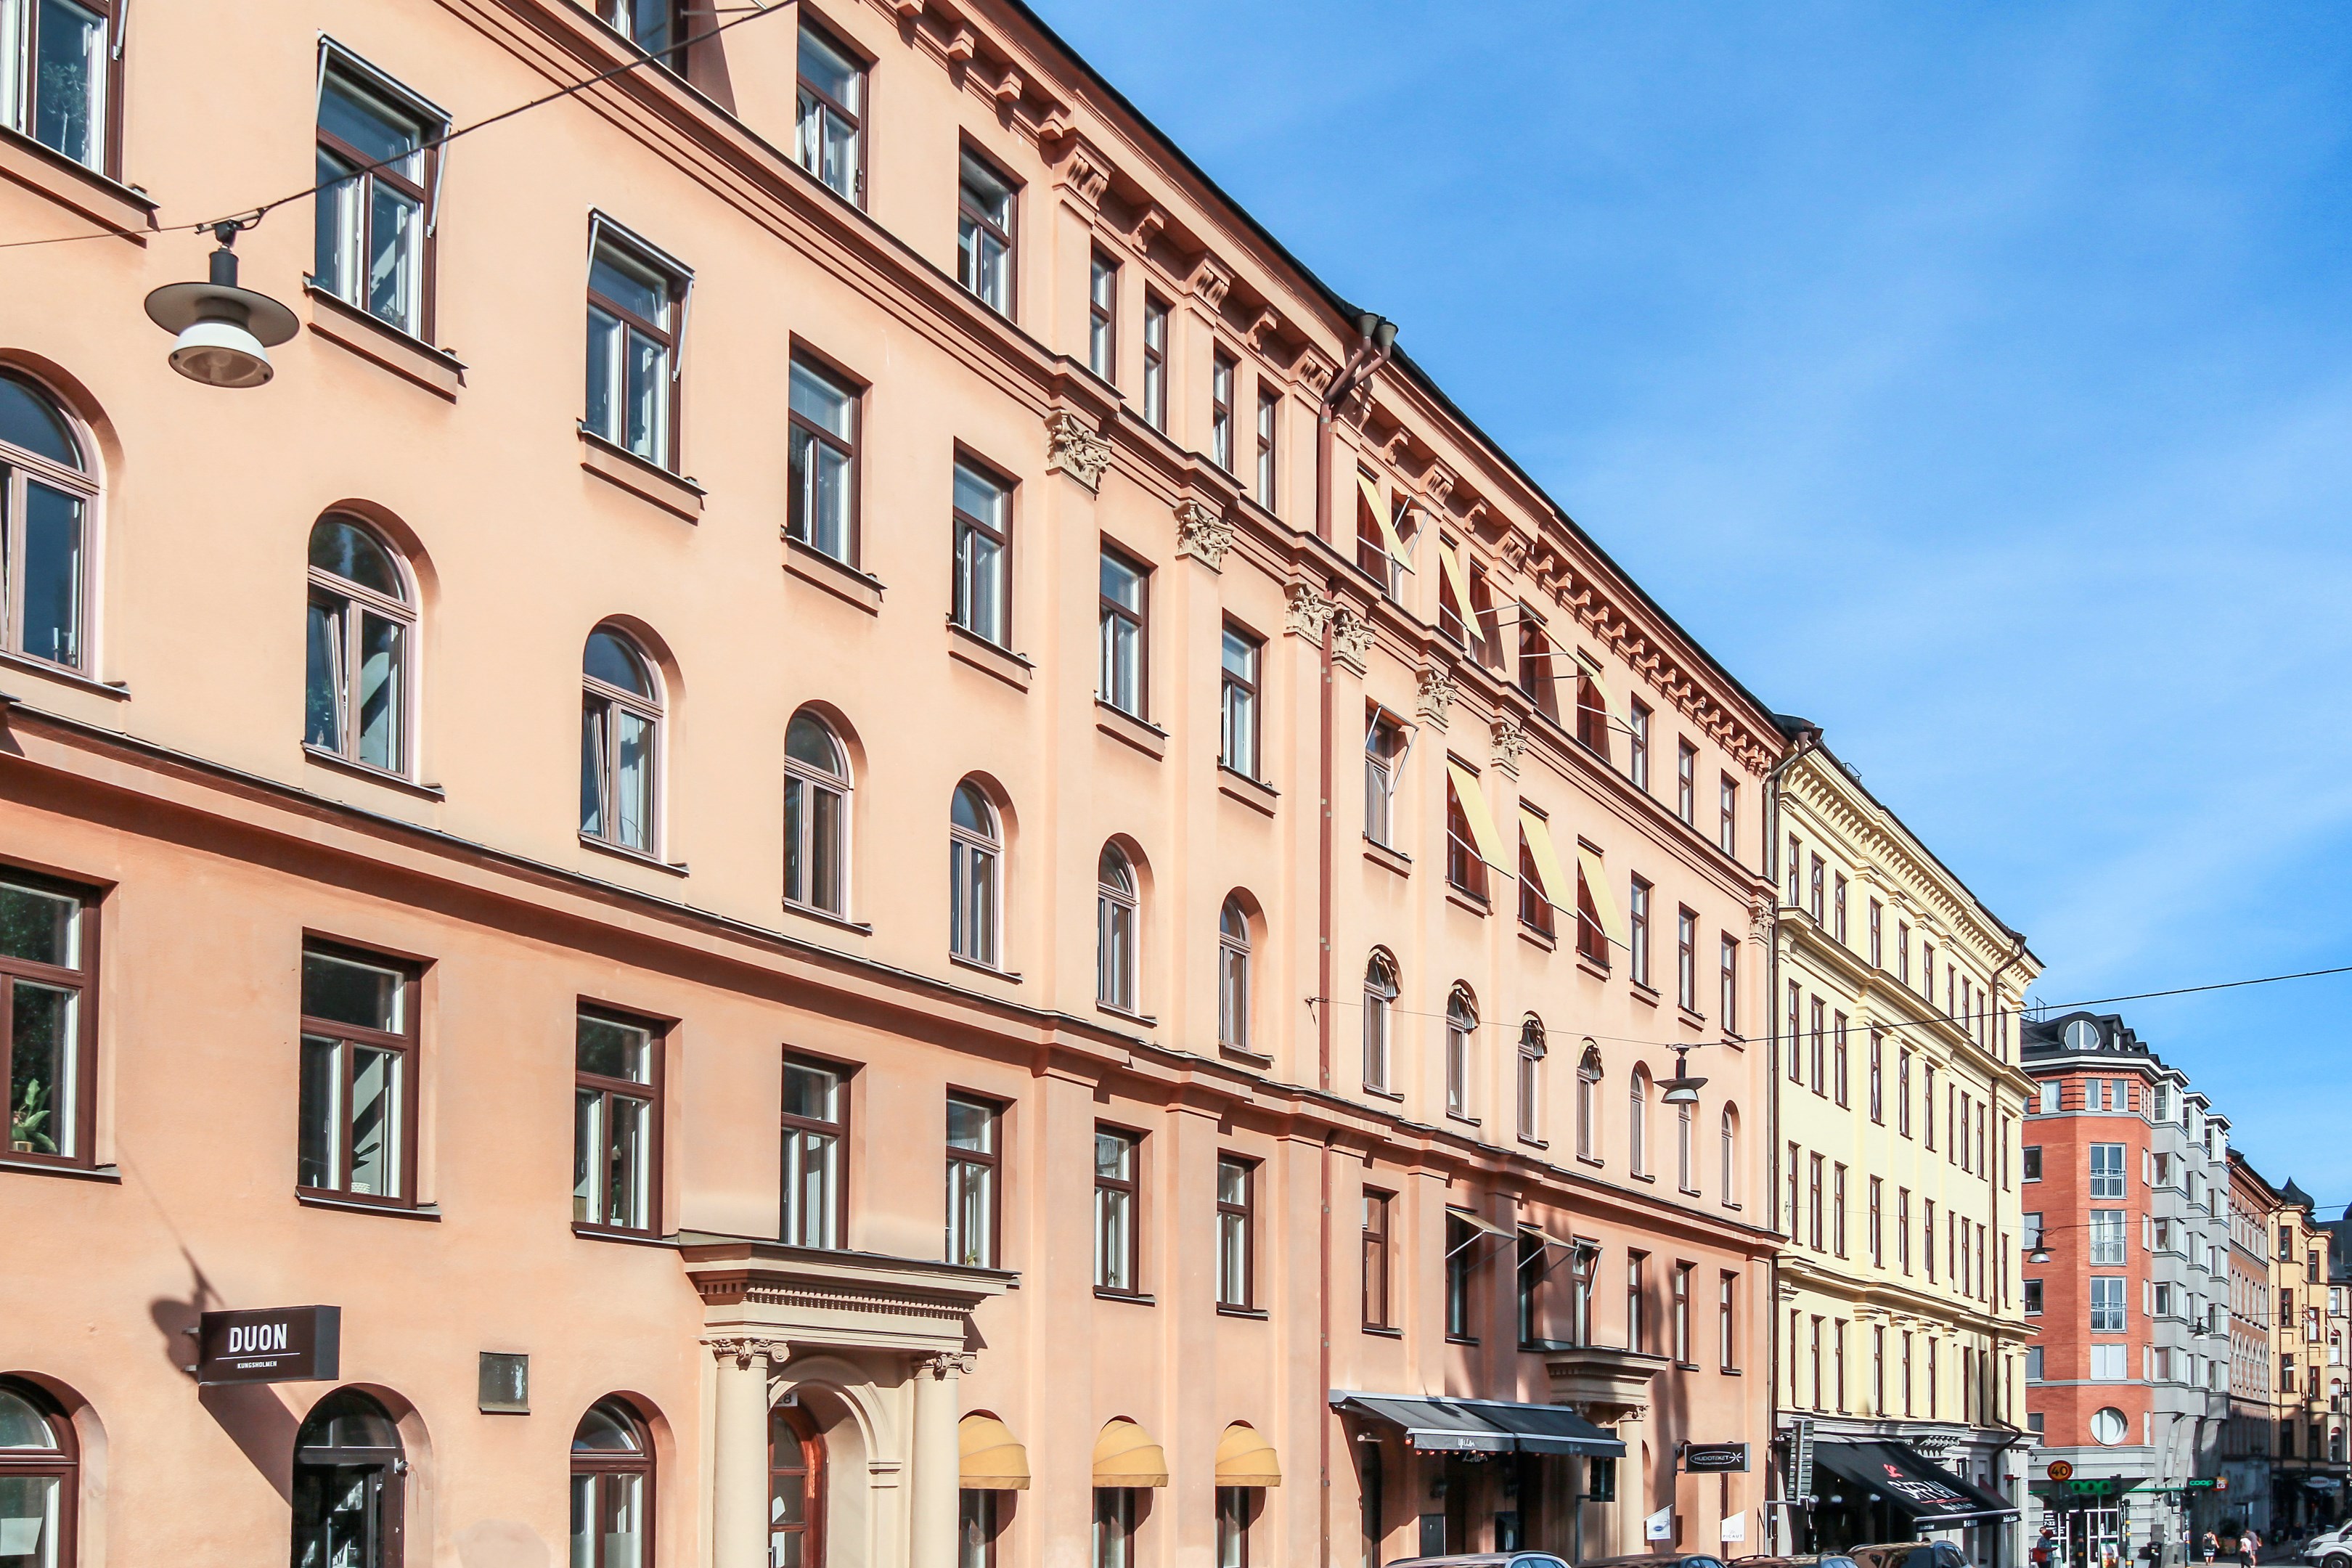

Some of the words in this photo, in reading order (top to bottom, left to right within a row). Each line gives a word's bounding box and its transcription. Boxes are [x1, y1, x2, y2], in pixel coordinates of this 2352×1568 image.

[229, 1323, 287, 1352] DUON
[237, 1360, 277, 1369] KUNGSHOLMEN
[2051, 1466, 2068, 1477] 40
